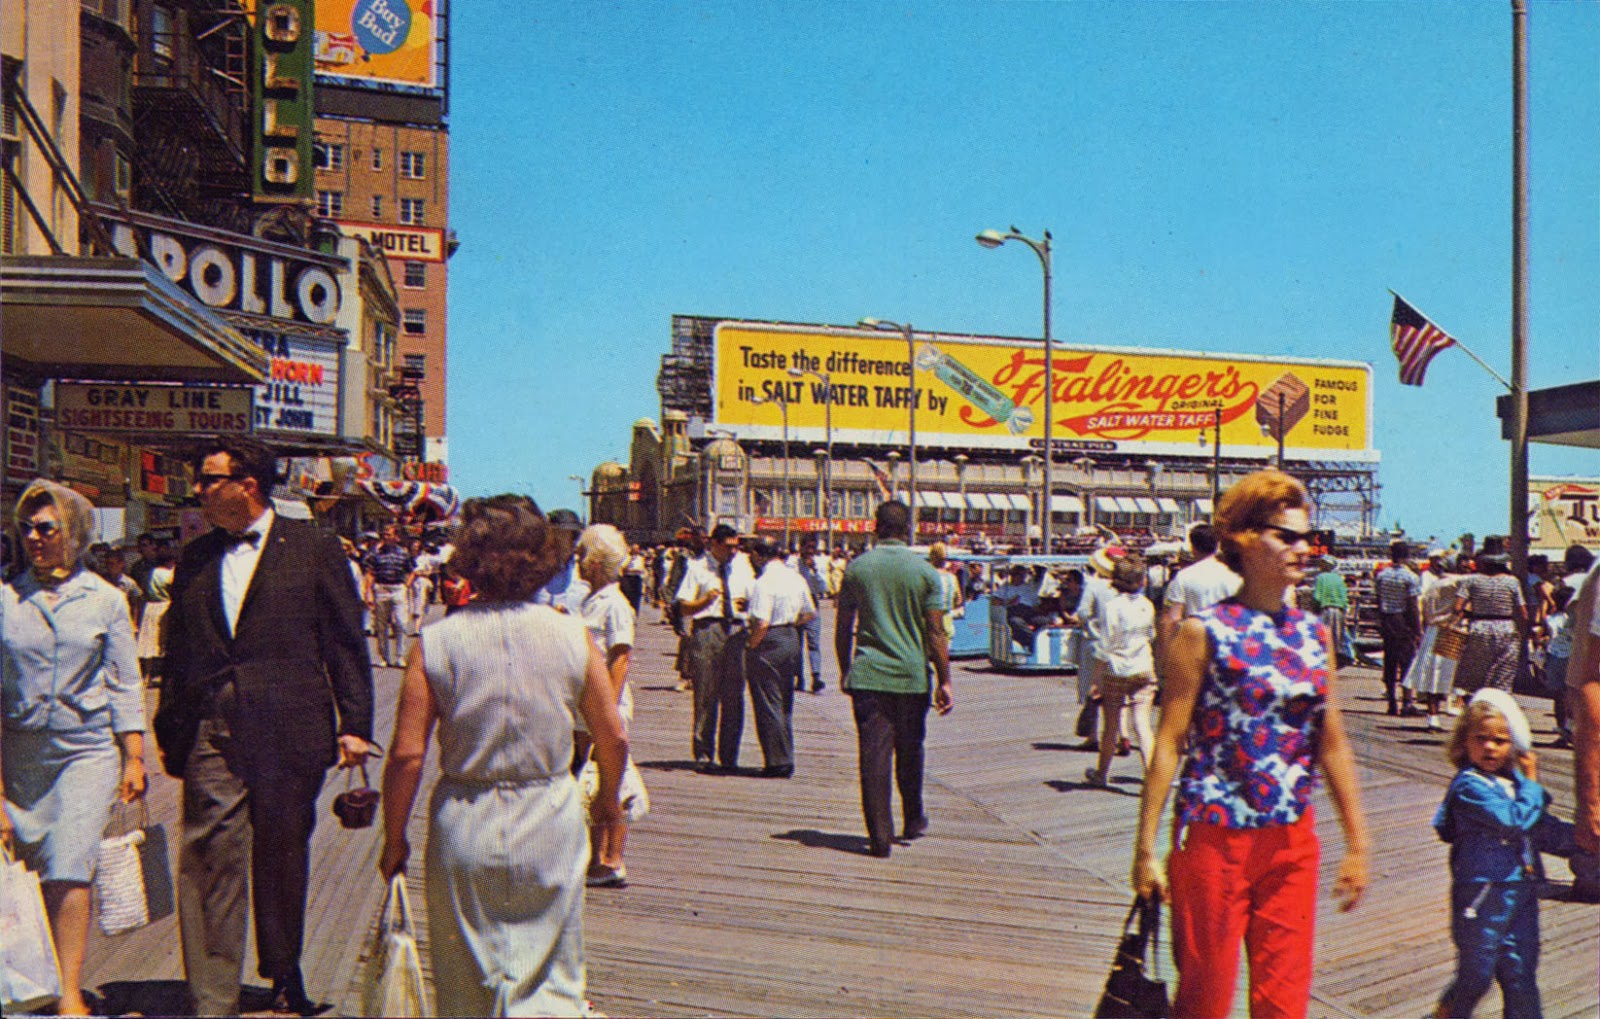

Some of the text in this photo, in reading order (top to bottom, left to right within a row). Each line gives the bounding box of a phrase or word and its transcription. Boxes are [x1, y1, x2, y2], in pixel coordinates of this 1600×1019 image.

[370, 0, 405, 29] Buy
[371, 231, 430, 253] MOTEL
[270, 357, 323, 387] HORN
[739, 346, 912, 376] Taste the difference
[261, 383, 303, 406] JILL
[970, 349, 1252, 422] Fralinger's
[1315, 379, 1357, 391] FAMOUS
[87, 388, 222, 410] GRAY LINE
[738, 379, 755, 401] in
[762, 380, 806, 403] SALT
[811, 382, 869, 407] WATER
[874, 385, 923, 409] TAFFY
[928, 389, 948, 416] by
[1171, 399, 1223, 409] ORIGINAL
[1314, 394, 1336, 404] FOR
[61, 408, 247, 430] SIGHTSEEING TOURS
[1087, 415, 1122, 429] SALT
[1125, 414, 1175, 426] WATER
[1314, 409, 1337, 420] FINE
[1313, 424, 1349, 436] FUDGE
